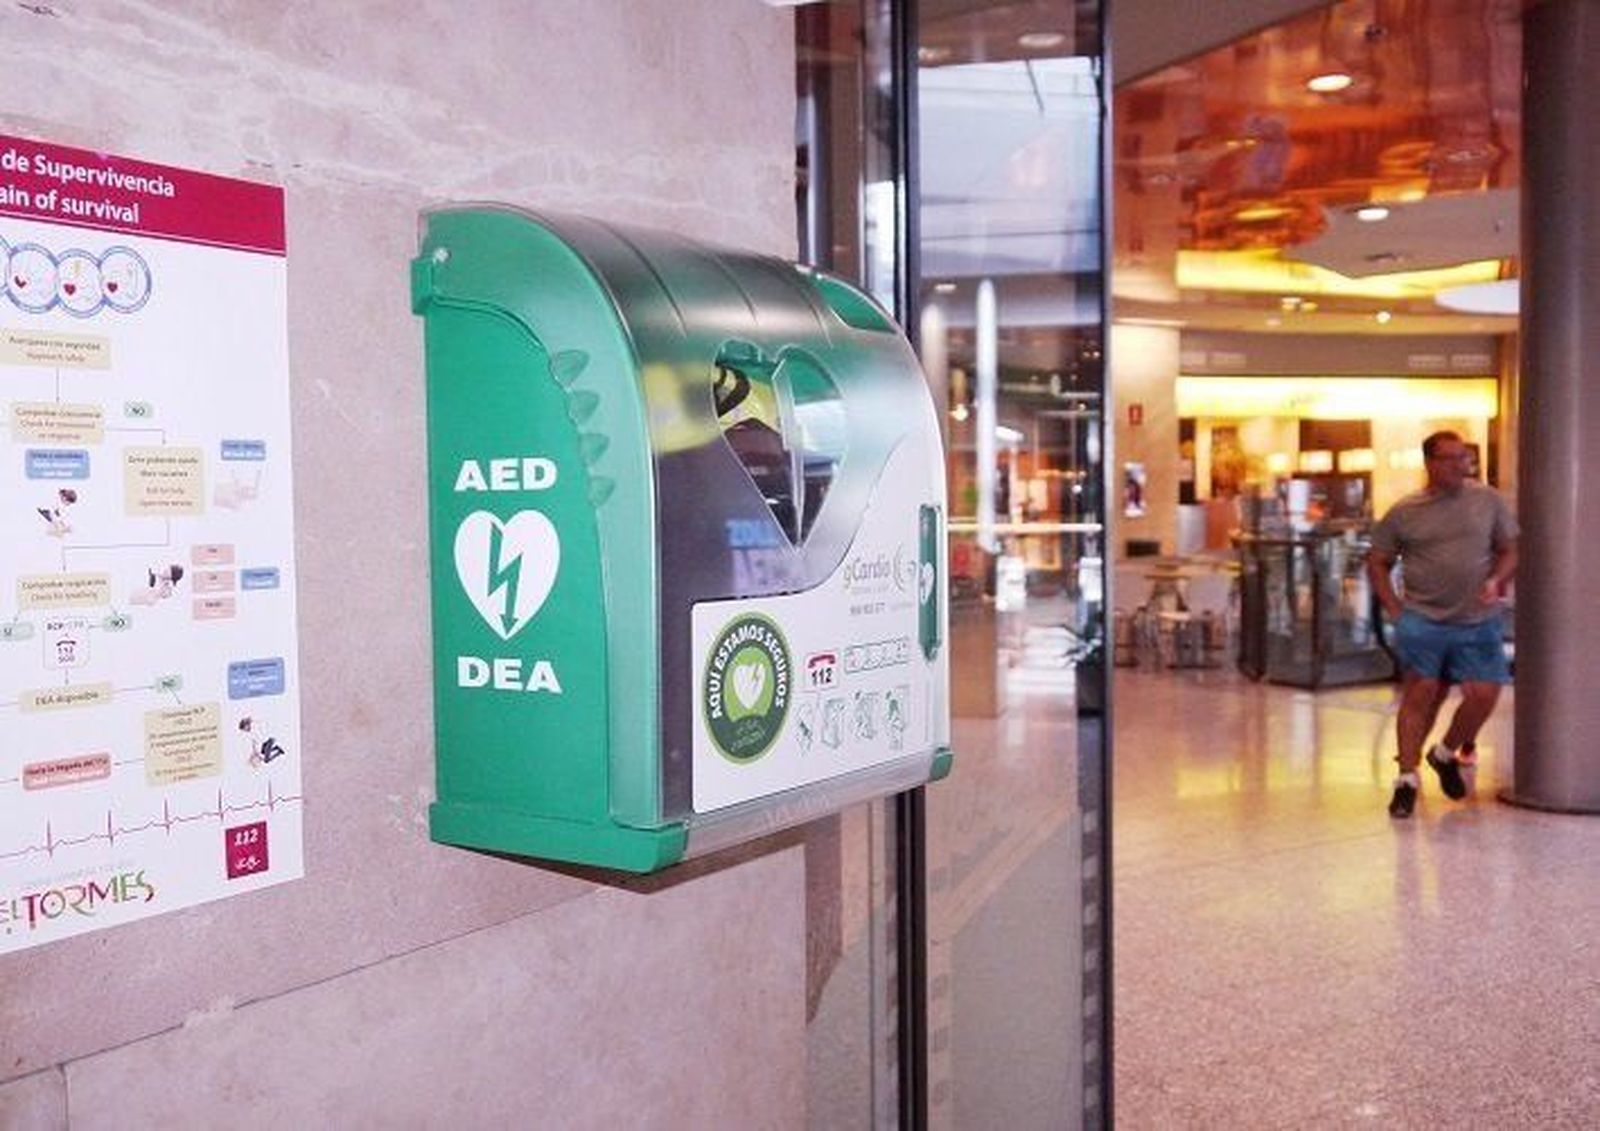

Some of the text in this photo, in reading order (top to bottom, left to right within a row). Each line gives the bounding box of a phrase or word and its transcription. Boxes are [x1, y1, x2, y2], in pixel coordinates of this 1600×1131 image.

[2, 148, 176, 198] de Supervivencia
[35, 189, 58, 211] of
[61, 197, 140, 224] survival
[453, 457, 558, 492] AED
[457, 655, 563, 695] DEA
[714, 624, 766, 672] ESTAMOS
[763, 633, 789, 708] SEGUROS
[811, 667, 833, 686] 112
[233, 827, 259, 847] 112
[22, 869, 155, 930] TORMES
